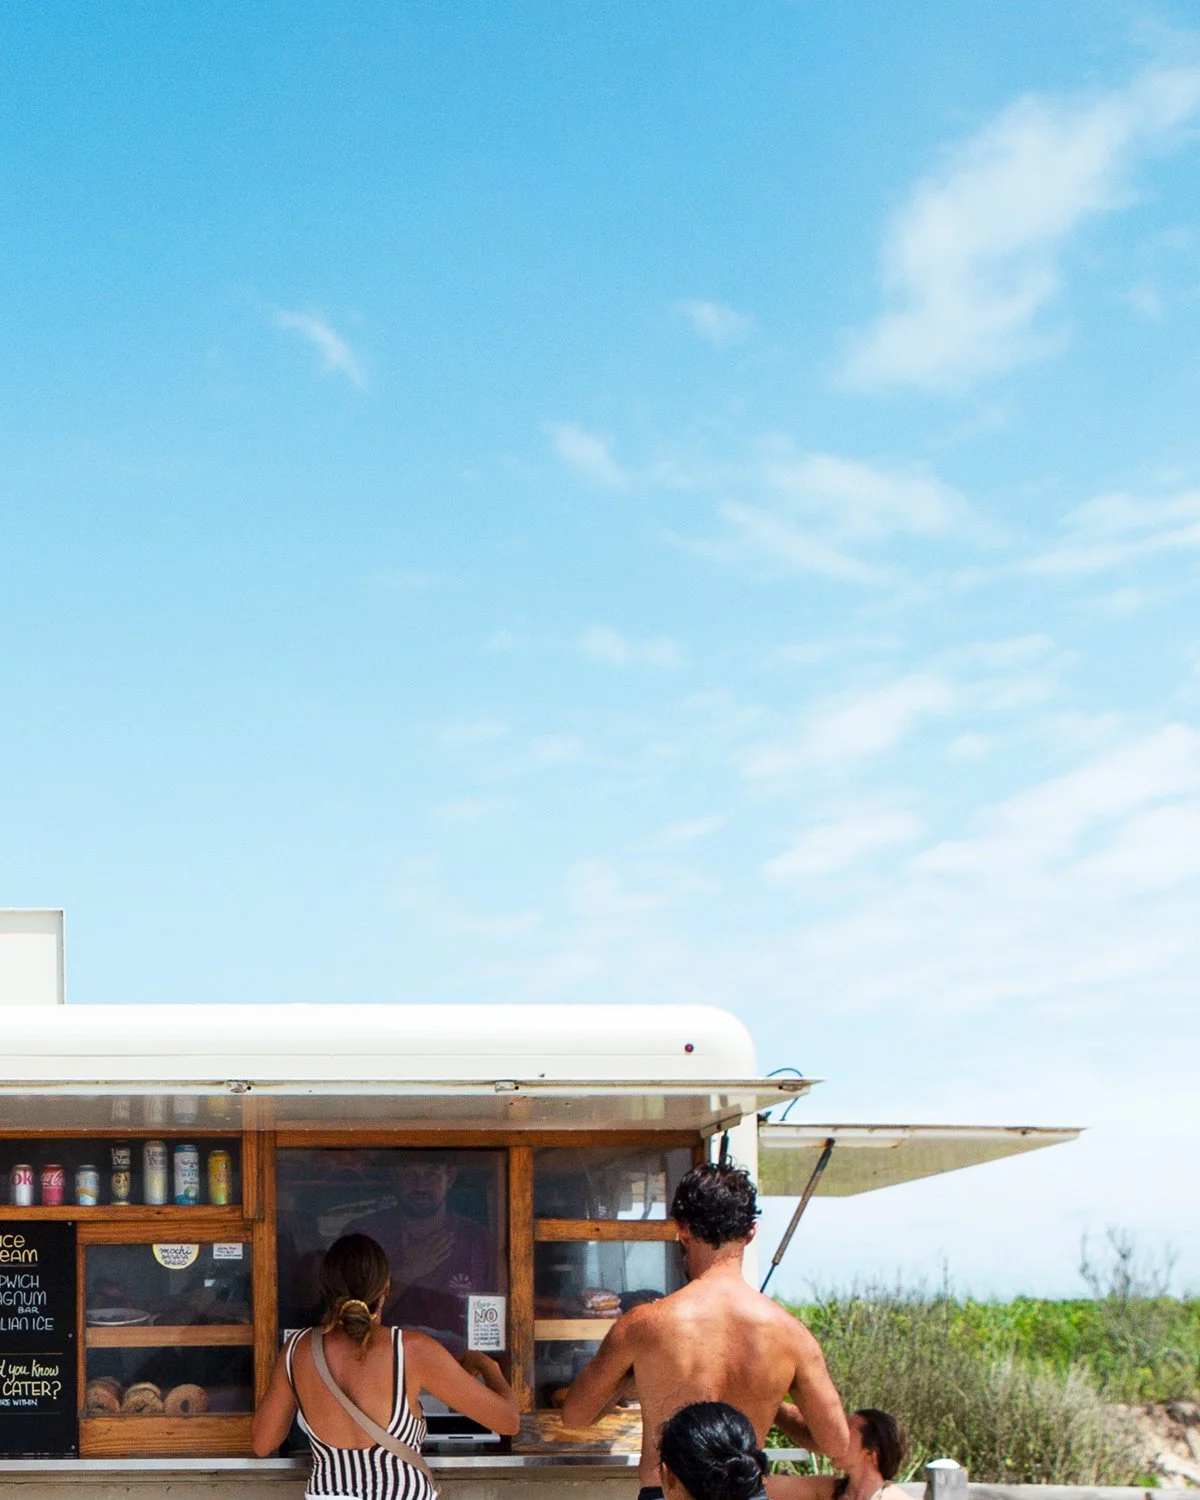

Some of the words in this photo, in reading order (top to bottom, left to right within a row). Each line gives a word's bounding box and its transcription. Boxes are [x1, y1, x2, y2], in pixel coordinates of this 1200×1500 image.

[159, 1245, 192, 1255] mochi
[17, 1306, 40, 1314] BAR
[474, 1308, 498, 1323] NO
[32, 1316, 54, 1331] ICE
[8, 1364, 30, 1384] you
[2, 1380, 62, 1400] CATER?
[12, 1398, 38, 1407] WITHIN
